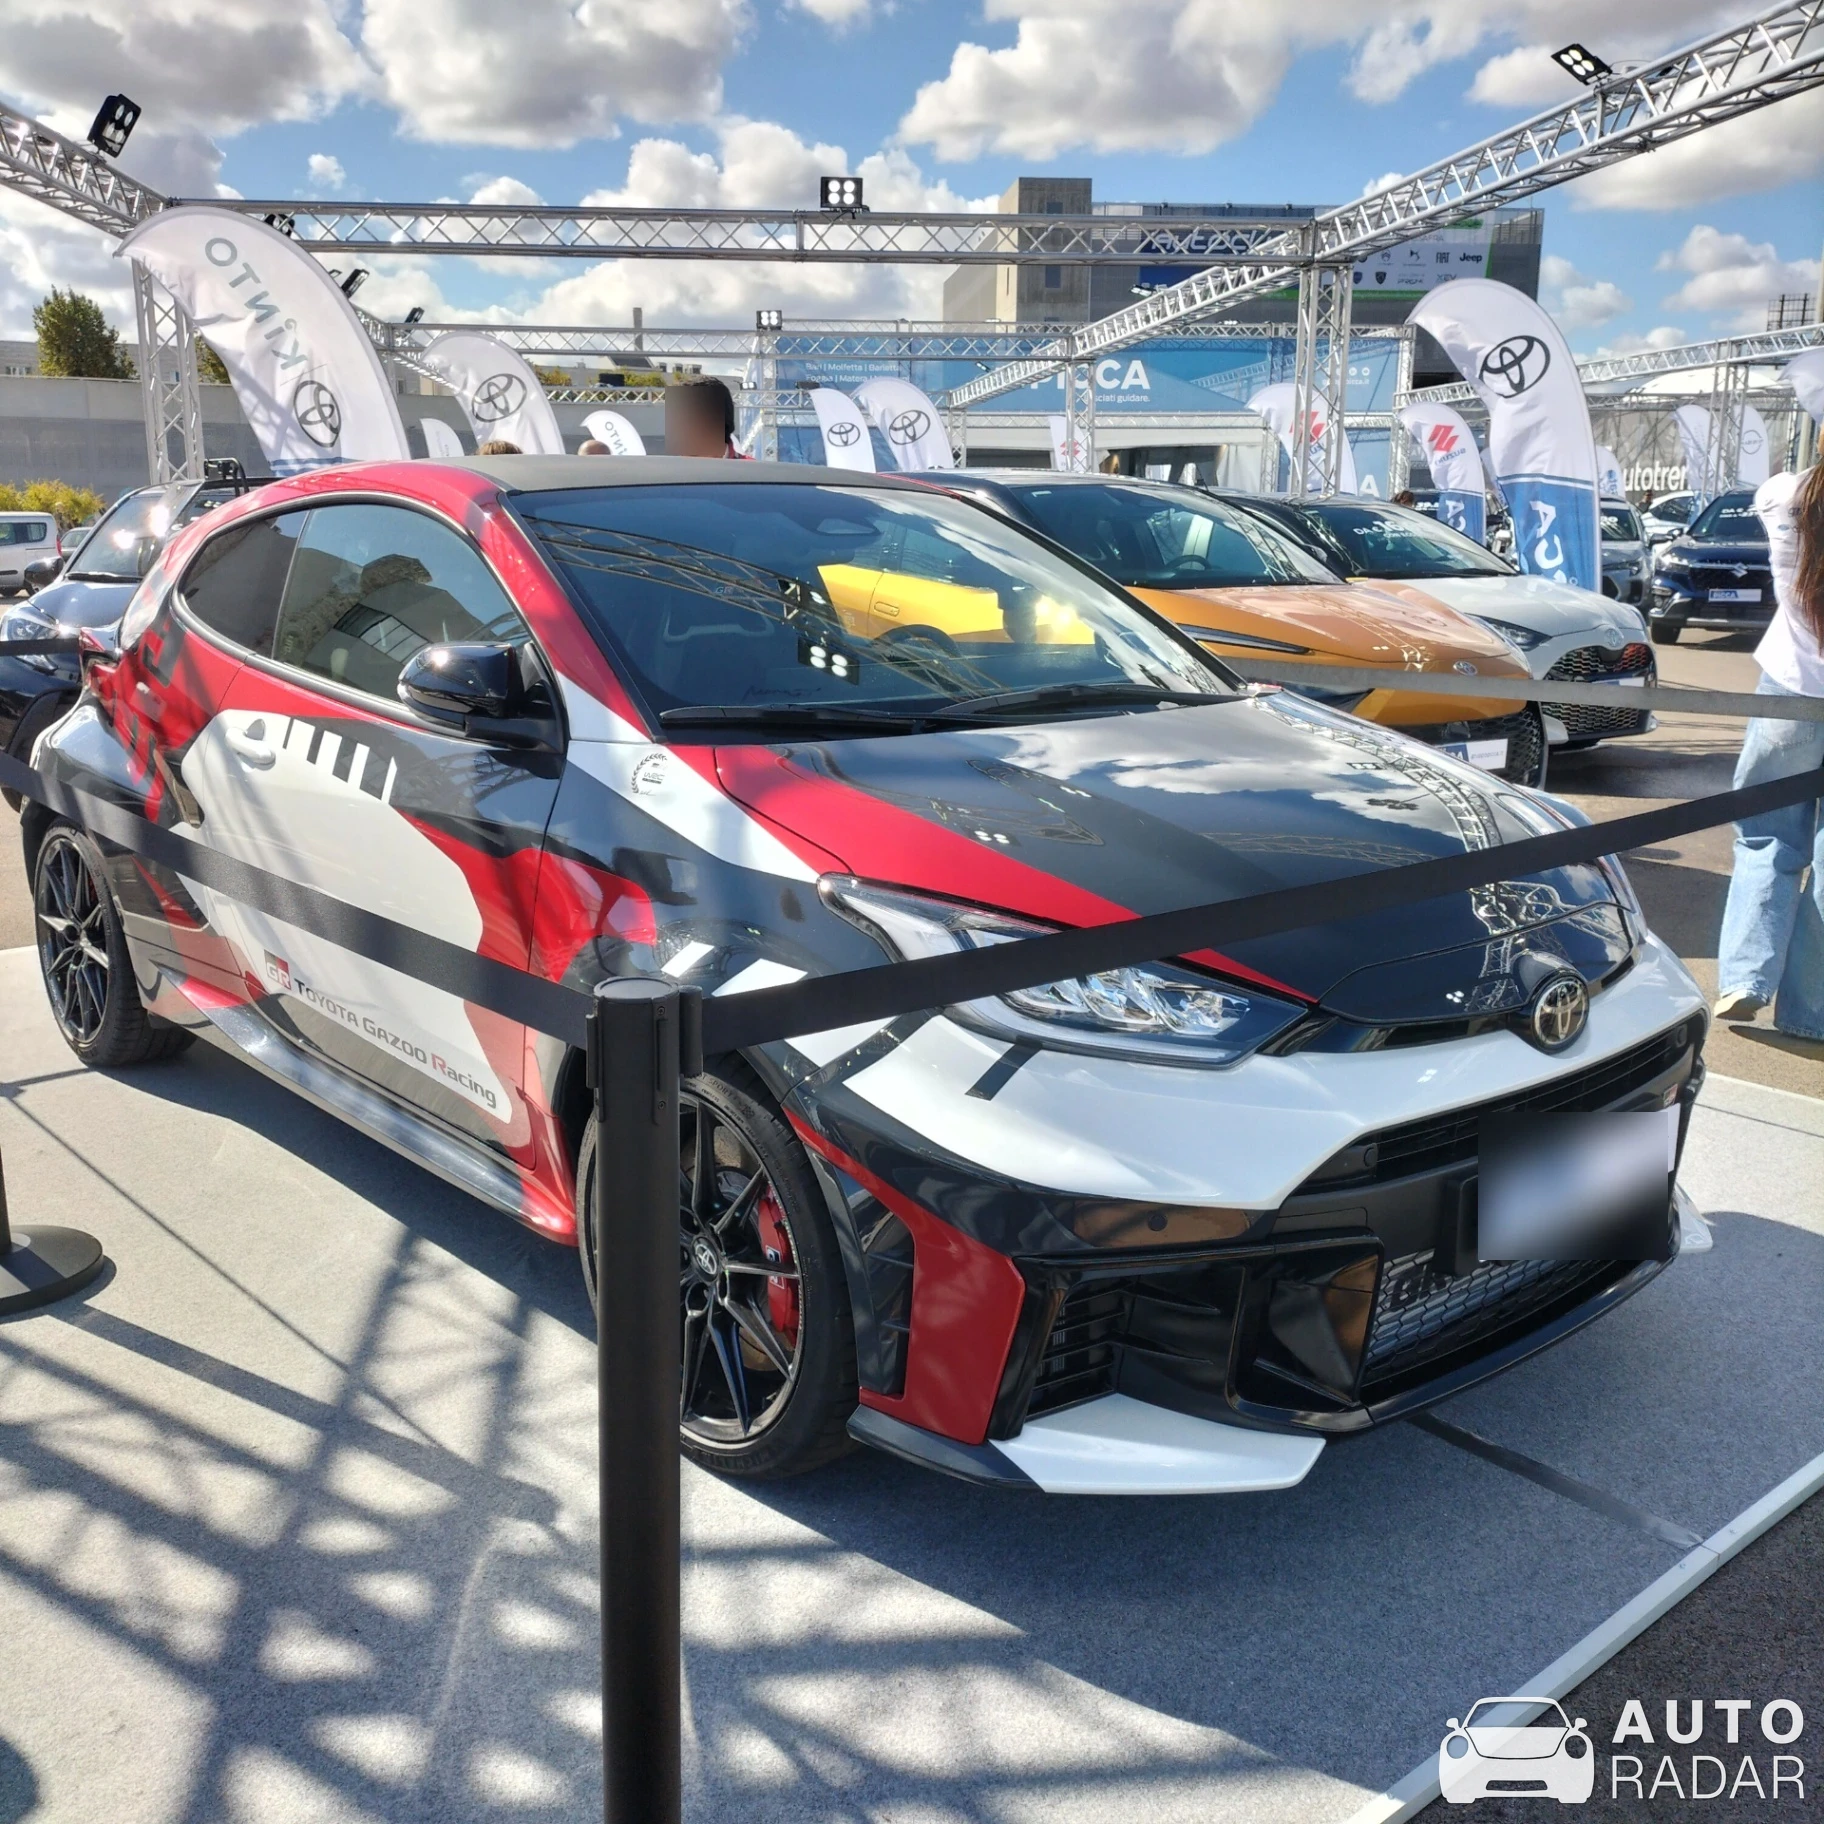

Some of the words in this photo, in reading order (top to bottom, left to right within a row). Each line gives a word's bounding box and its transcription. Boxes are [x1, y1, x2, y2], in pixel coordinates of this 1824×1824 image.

[1459, 252, 1483, 264] Jeep
[827, 362, 863, 371] Molfetta
[266, 960, 292, 990] GR
[293, 976, 360, 1029] TOYOTA
[362, 1016, 428, 1065] GAZOO
[431, 1052, 498, 1110] Racing
